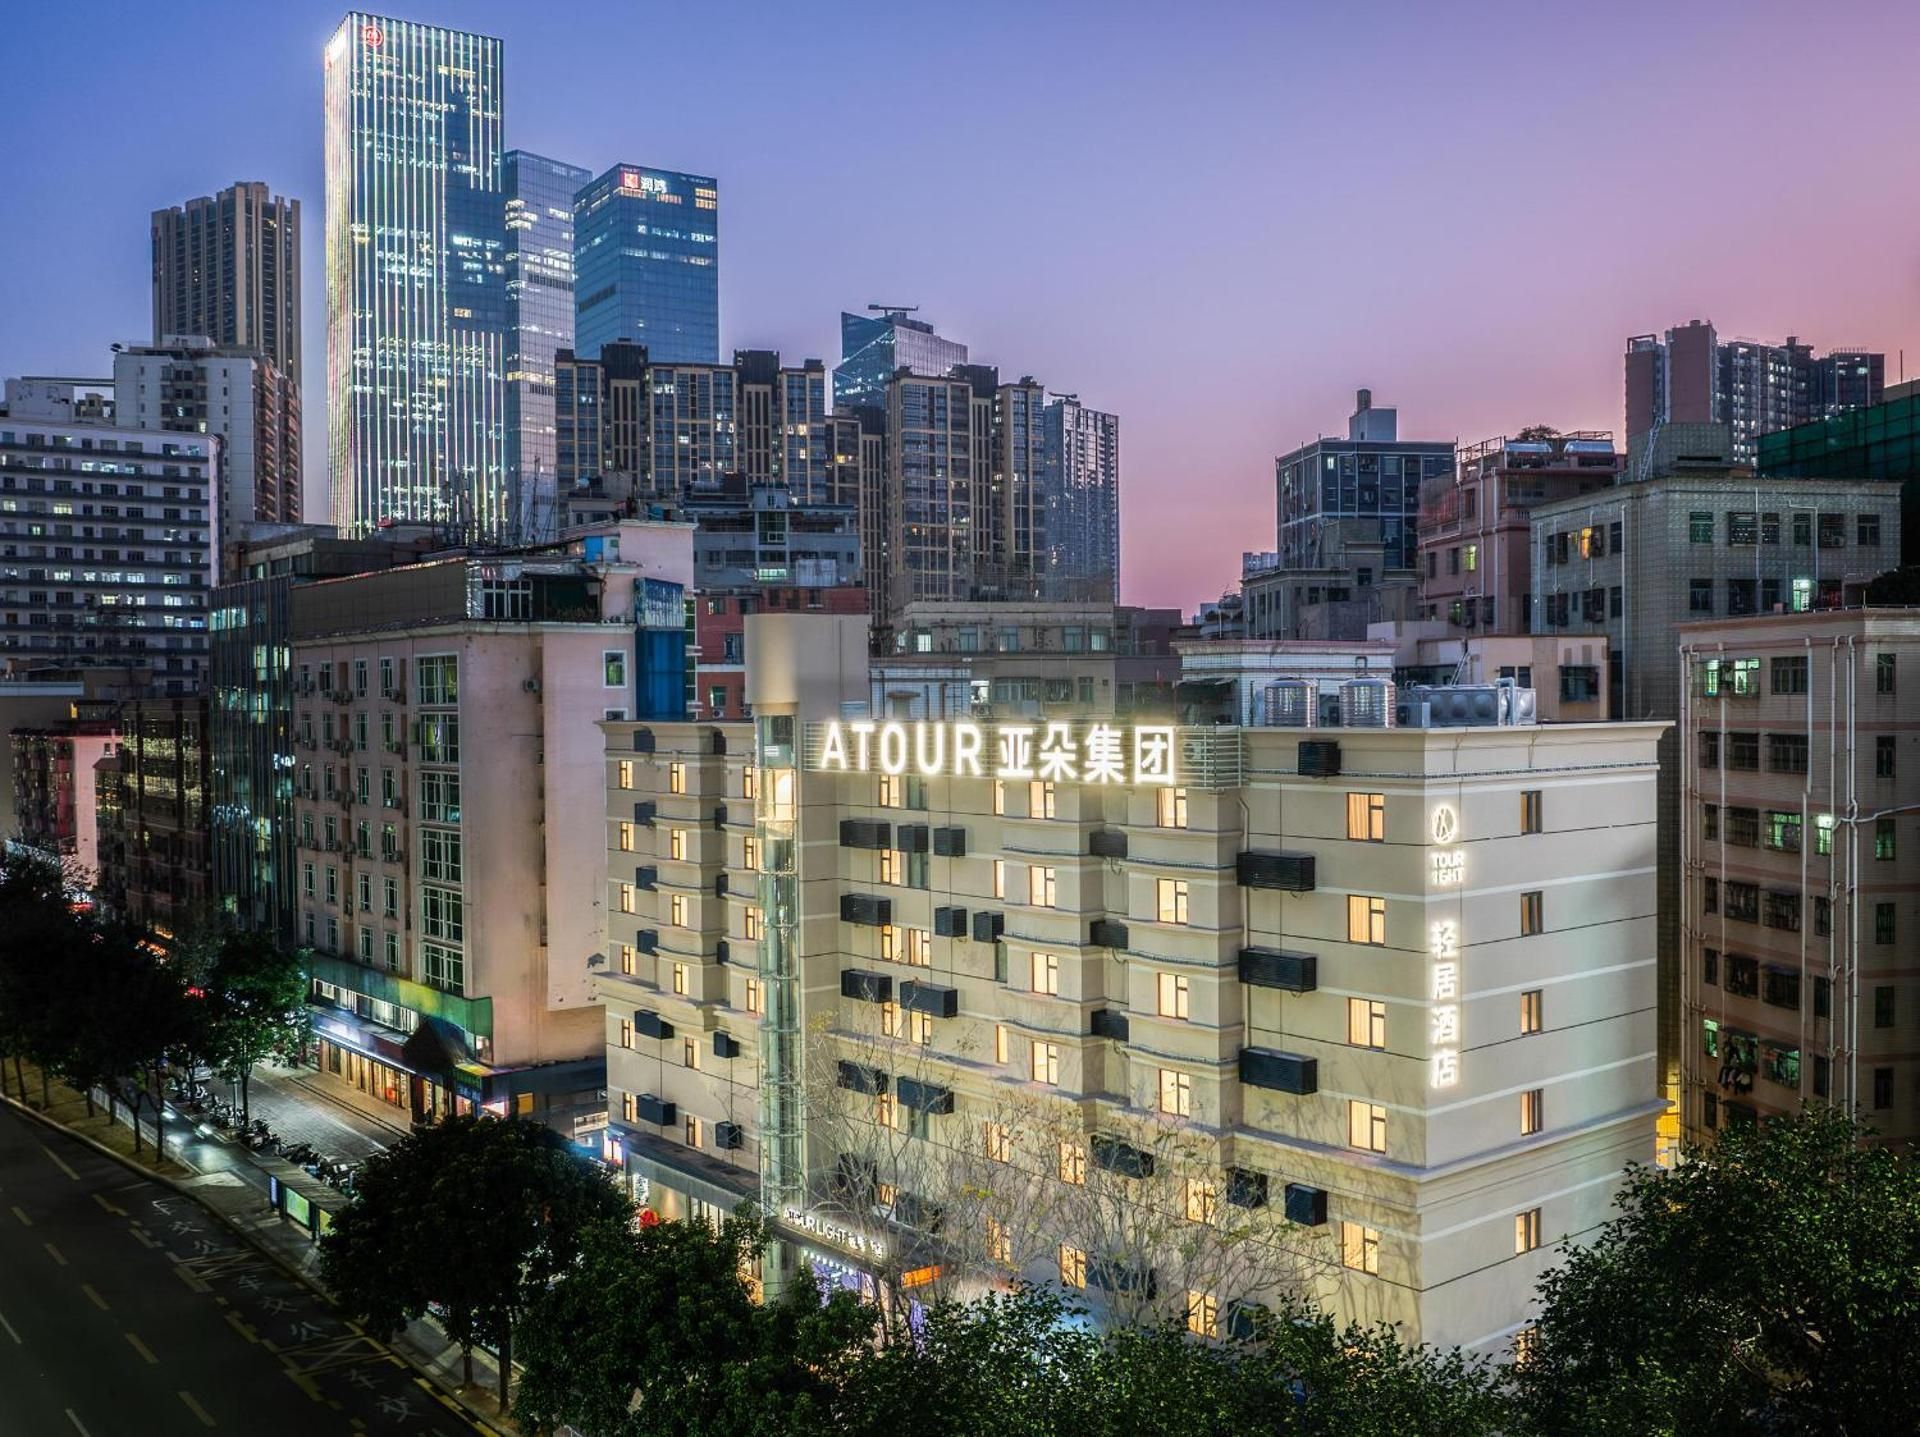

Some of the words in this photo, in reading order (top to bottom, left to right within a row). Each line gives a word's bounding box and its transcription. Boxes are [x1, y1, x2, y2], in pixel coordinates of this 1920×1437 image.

[820, 721, 982, 776] ATOUR
[999, 723, 1176, 784] 亚朵集团
[816, 1219, 848, 1245] LIGHT
